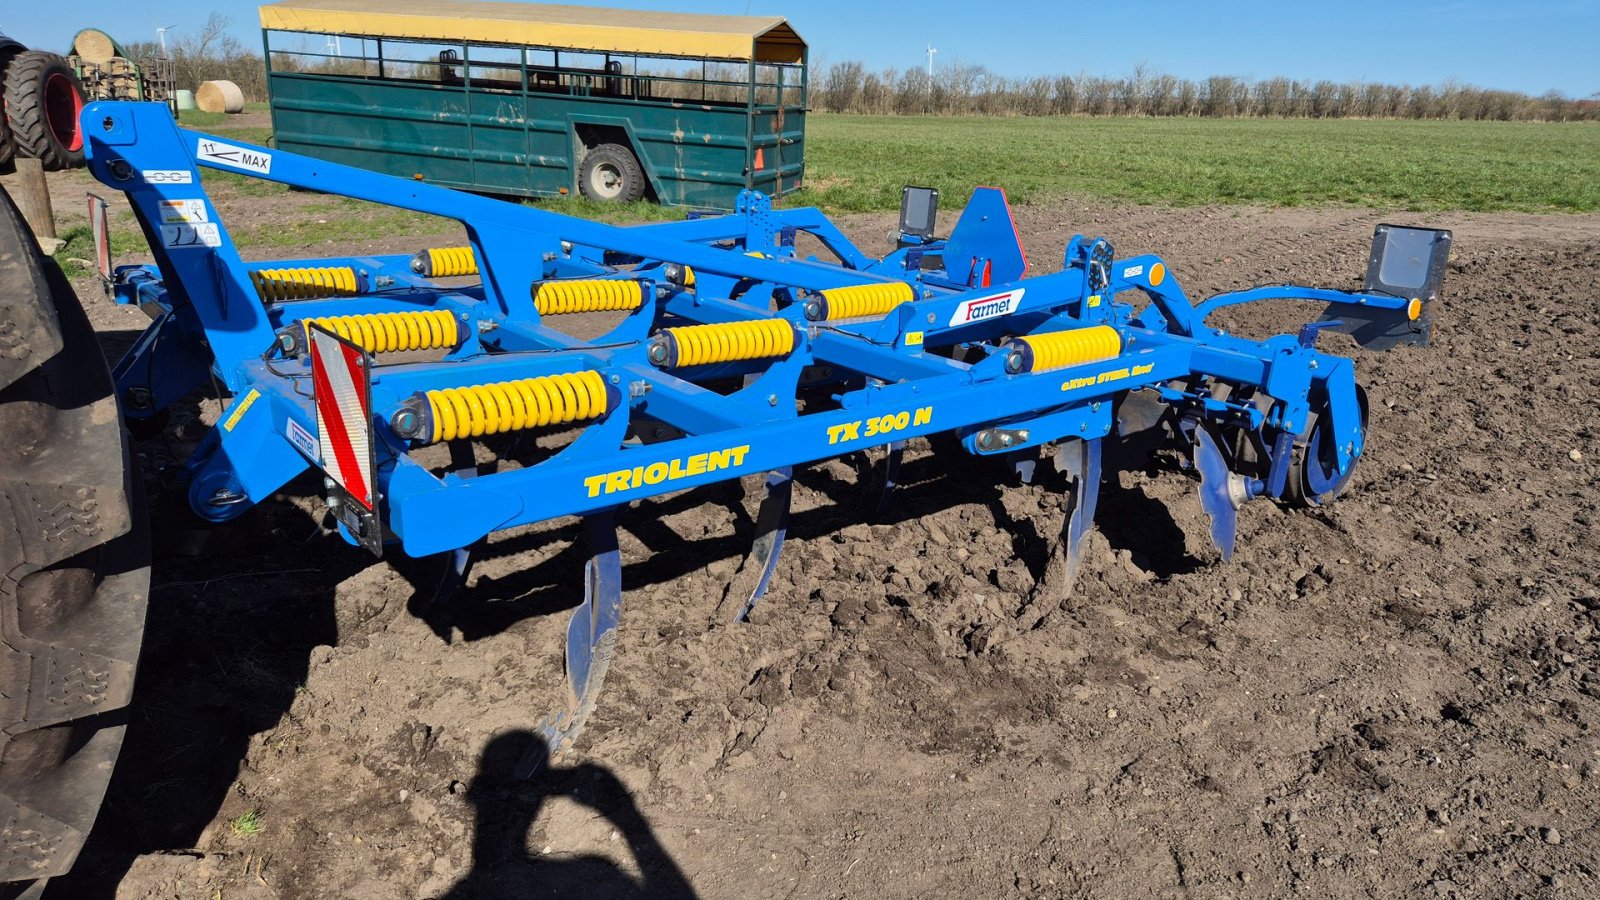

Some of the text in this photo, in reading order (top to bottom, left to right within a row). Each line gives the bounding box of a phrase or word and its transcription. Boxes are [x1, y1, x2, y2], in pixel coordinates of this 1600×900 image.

[242, 153, 268, 169] MAX
[966, 293, 1012, 320] Farmet
[1097, 368, 1130, 384] STEEL
[826, 406, 933, 445] TX 300 N
[584, 444, 750, 498] TRIOLENT
